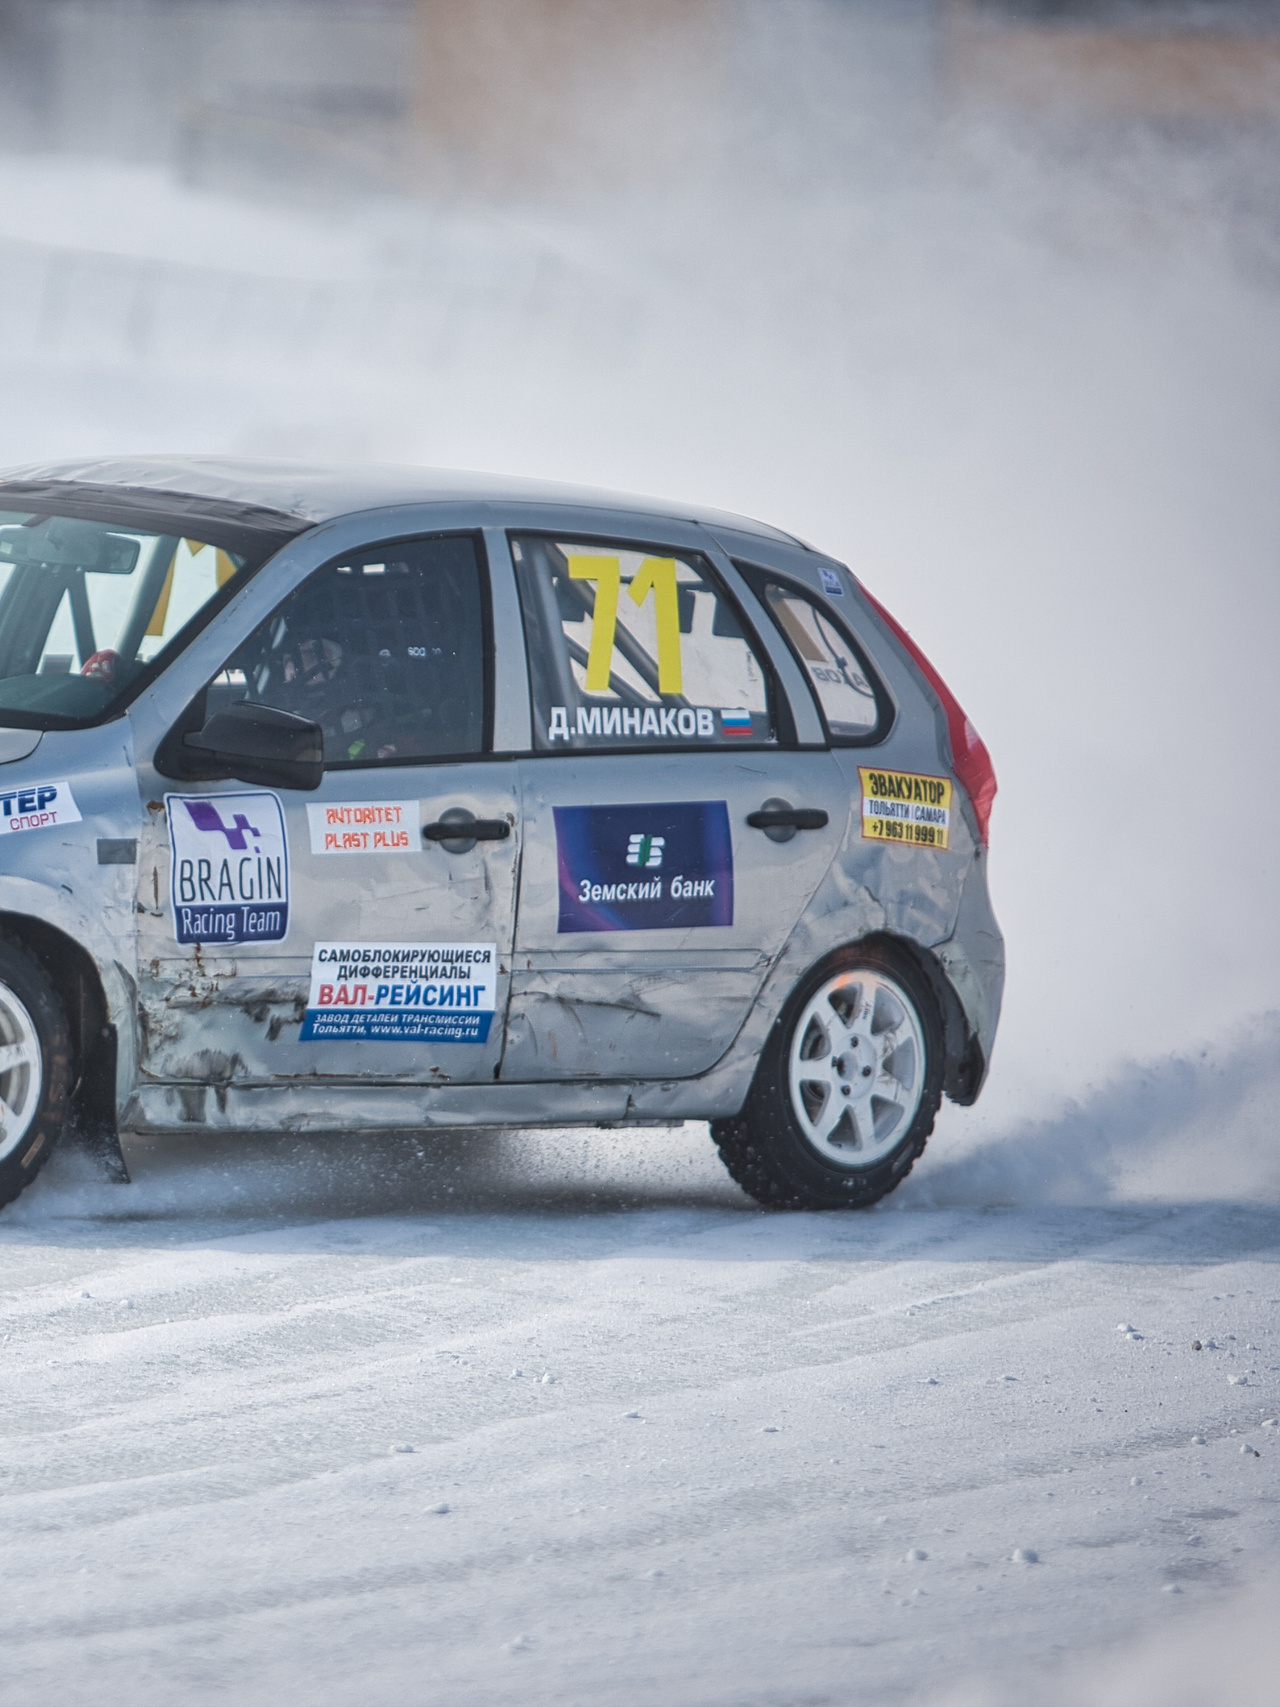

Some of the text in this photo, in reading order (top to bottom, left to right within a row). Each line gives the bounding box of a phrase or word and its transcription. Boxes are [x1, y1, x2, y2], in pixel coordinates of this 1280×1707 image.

[567, 555, 683, 694] 71
[548, 706, 715, 740] Д.МИНАКОВ
[868, 773, 945, 804] ЭВАКУАТОР
[9, 811, 58, 831] СПОРТ
[326, 805, 402, 825] AUTORITET
[869, 799, 946, 824] ТОЛЬЯТТИ САМАРА
[324, 830, 409, 850] PLAST PLUS
[885, 820, 904, 839] 963
[179, 854, 283, 902] BRAGIN
[578, 874, 715, 902] Земский банк
[182, 905, 282, 940] Racing Team
[318, 949, 492, 964] САМОБЛОКИРУЮЩИЕСЯ
[337, 965, 471, 981] ДИФФЕРЕНЦИАЛЫ
[317, 980, 486, 1007] ВАЛ-РЕЙСИНГ
[315, 1013, 349, 1024] ЗАВОД
[401, 1013, 480, 1025] ТРАНСМИССИИ
[312, 1023, 479, 1038] Тольятти, www.val-racing.ru
